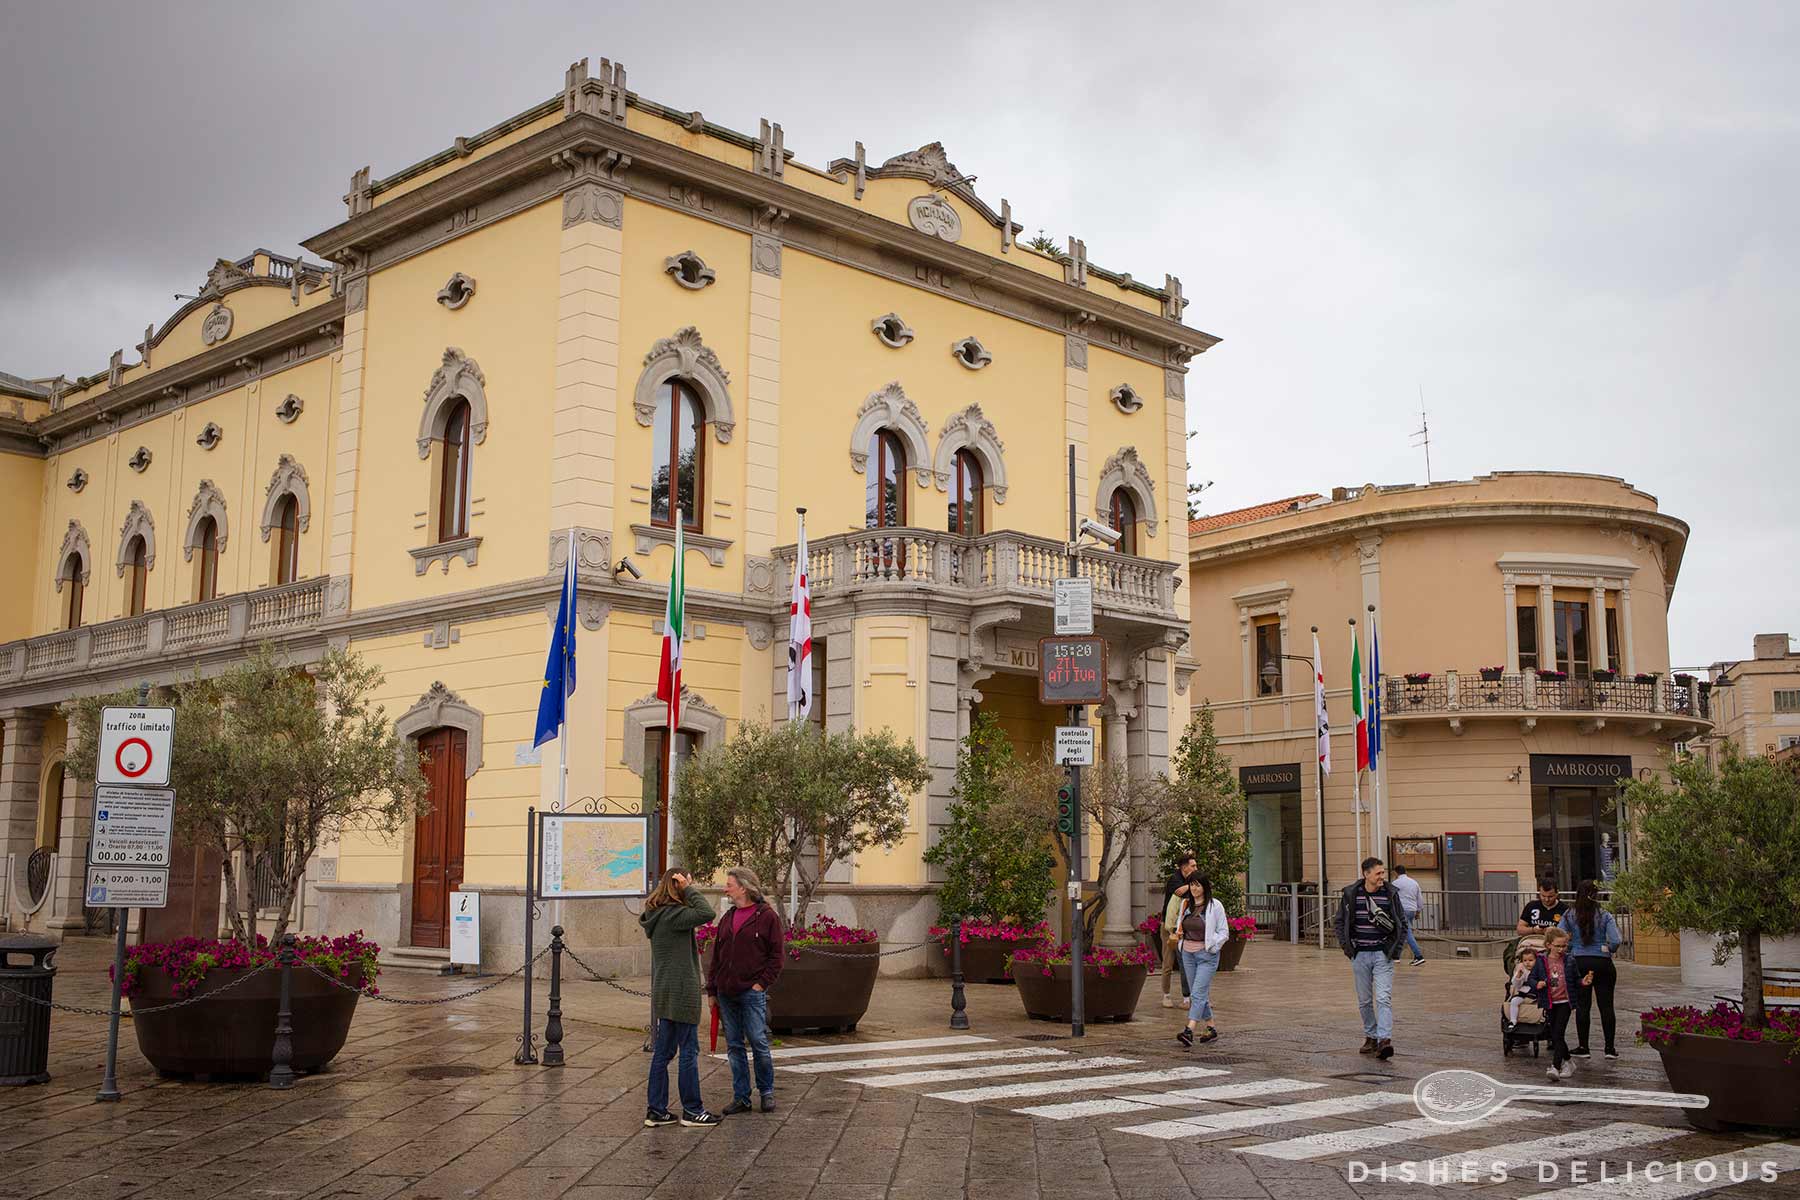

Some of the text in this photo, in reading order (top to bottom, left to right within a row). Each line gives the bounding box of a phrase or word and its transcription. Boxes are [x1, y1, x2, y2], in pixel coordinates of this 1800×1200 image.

[1055, 645, 1092, 658] 15:20
[1056, 657, 1079, 670] ZTL
[1048, 670, 1096, 683] ATTIVA
[106, 722, 170, 732] traffico limitato
[1067, 747, 1082, 755] degli
[1546, 763, 1621, 776] AMBROSIO
[1246, 772, 1293, 784] AMBROSIO
[98, 852, 126, 861] 00.00
[135, 853, 163, 862] 24.00
[141, 876, 162, 884] 11,00
[1531, 909, 1540, 920] 3
